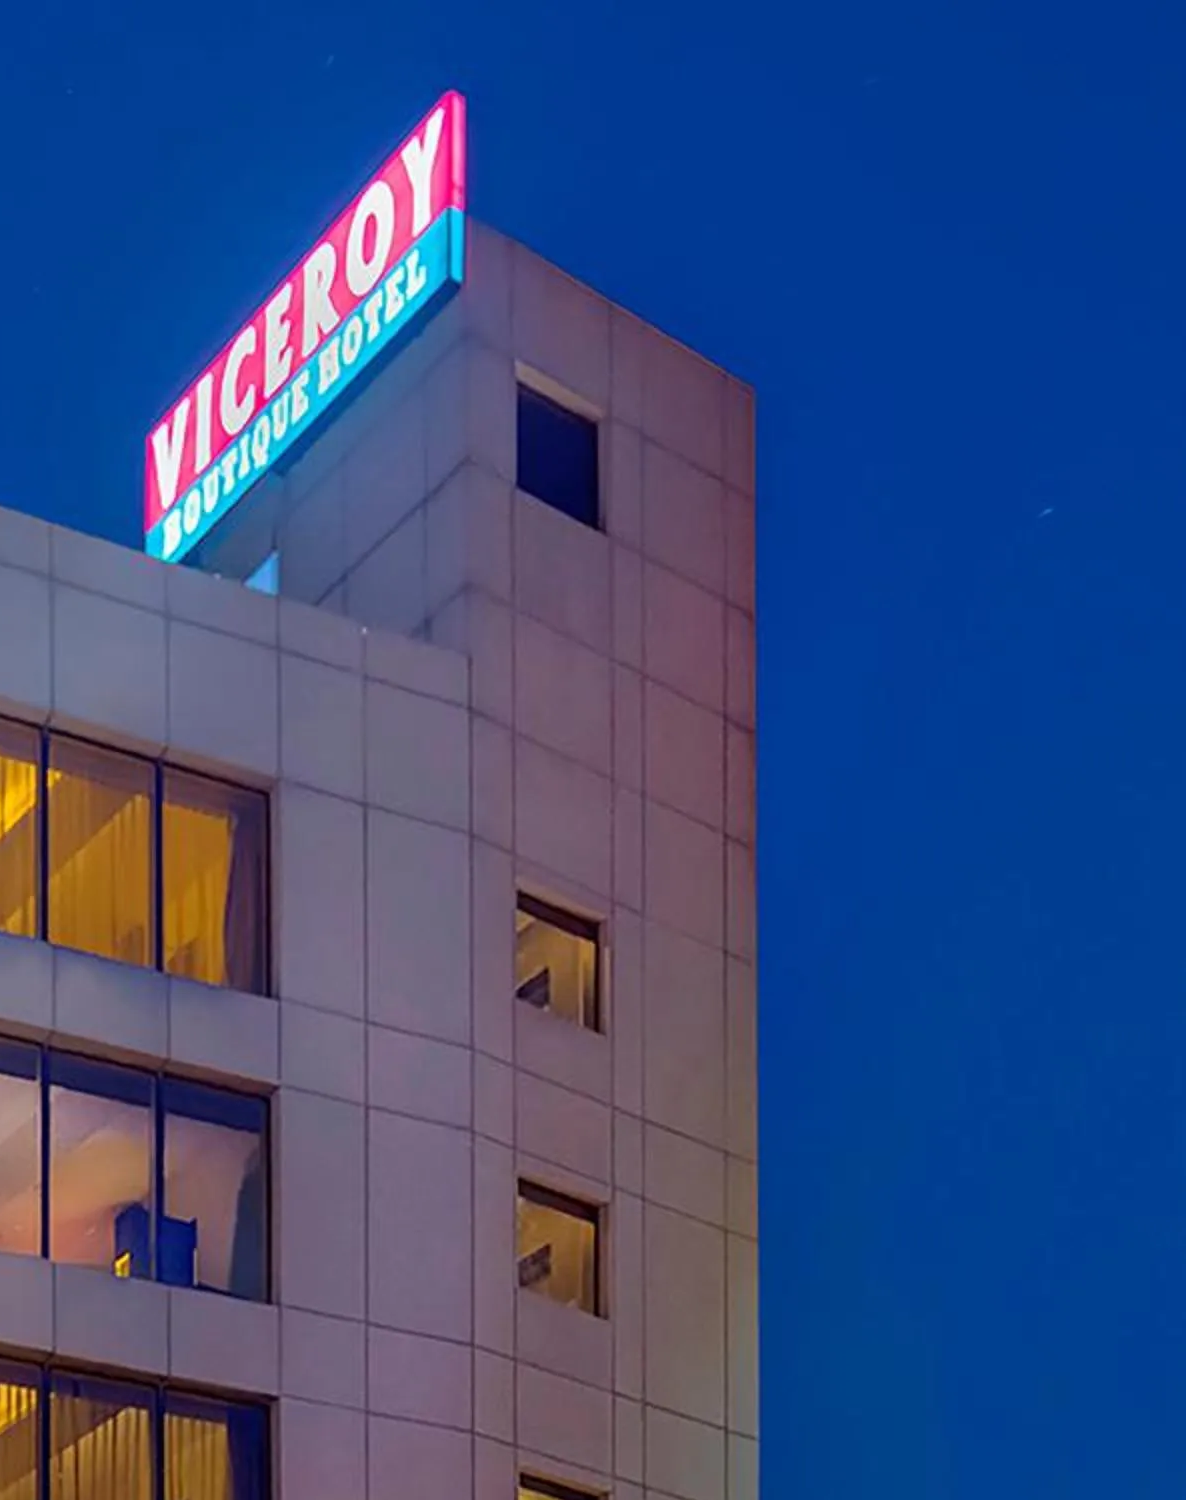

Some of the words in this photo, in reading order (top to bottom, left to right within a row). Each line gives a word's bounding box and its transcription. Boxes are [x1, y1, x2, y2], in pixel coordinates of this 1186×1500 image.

[151, 107, 445, 511] VICEROY
[161, 368, 310, 560] BOUTIQUE
[318, 248, 427, 394] HOTEL
